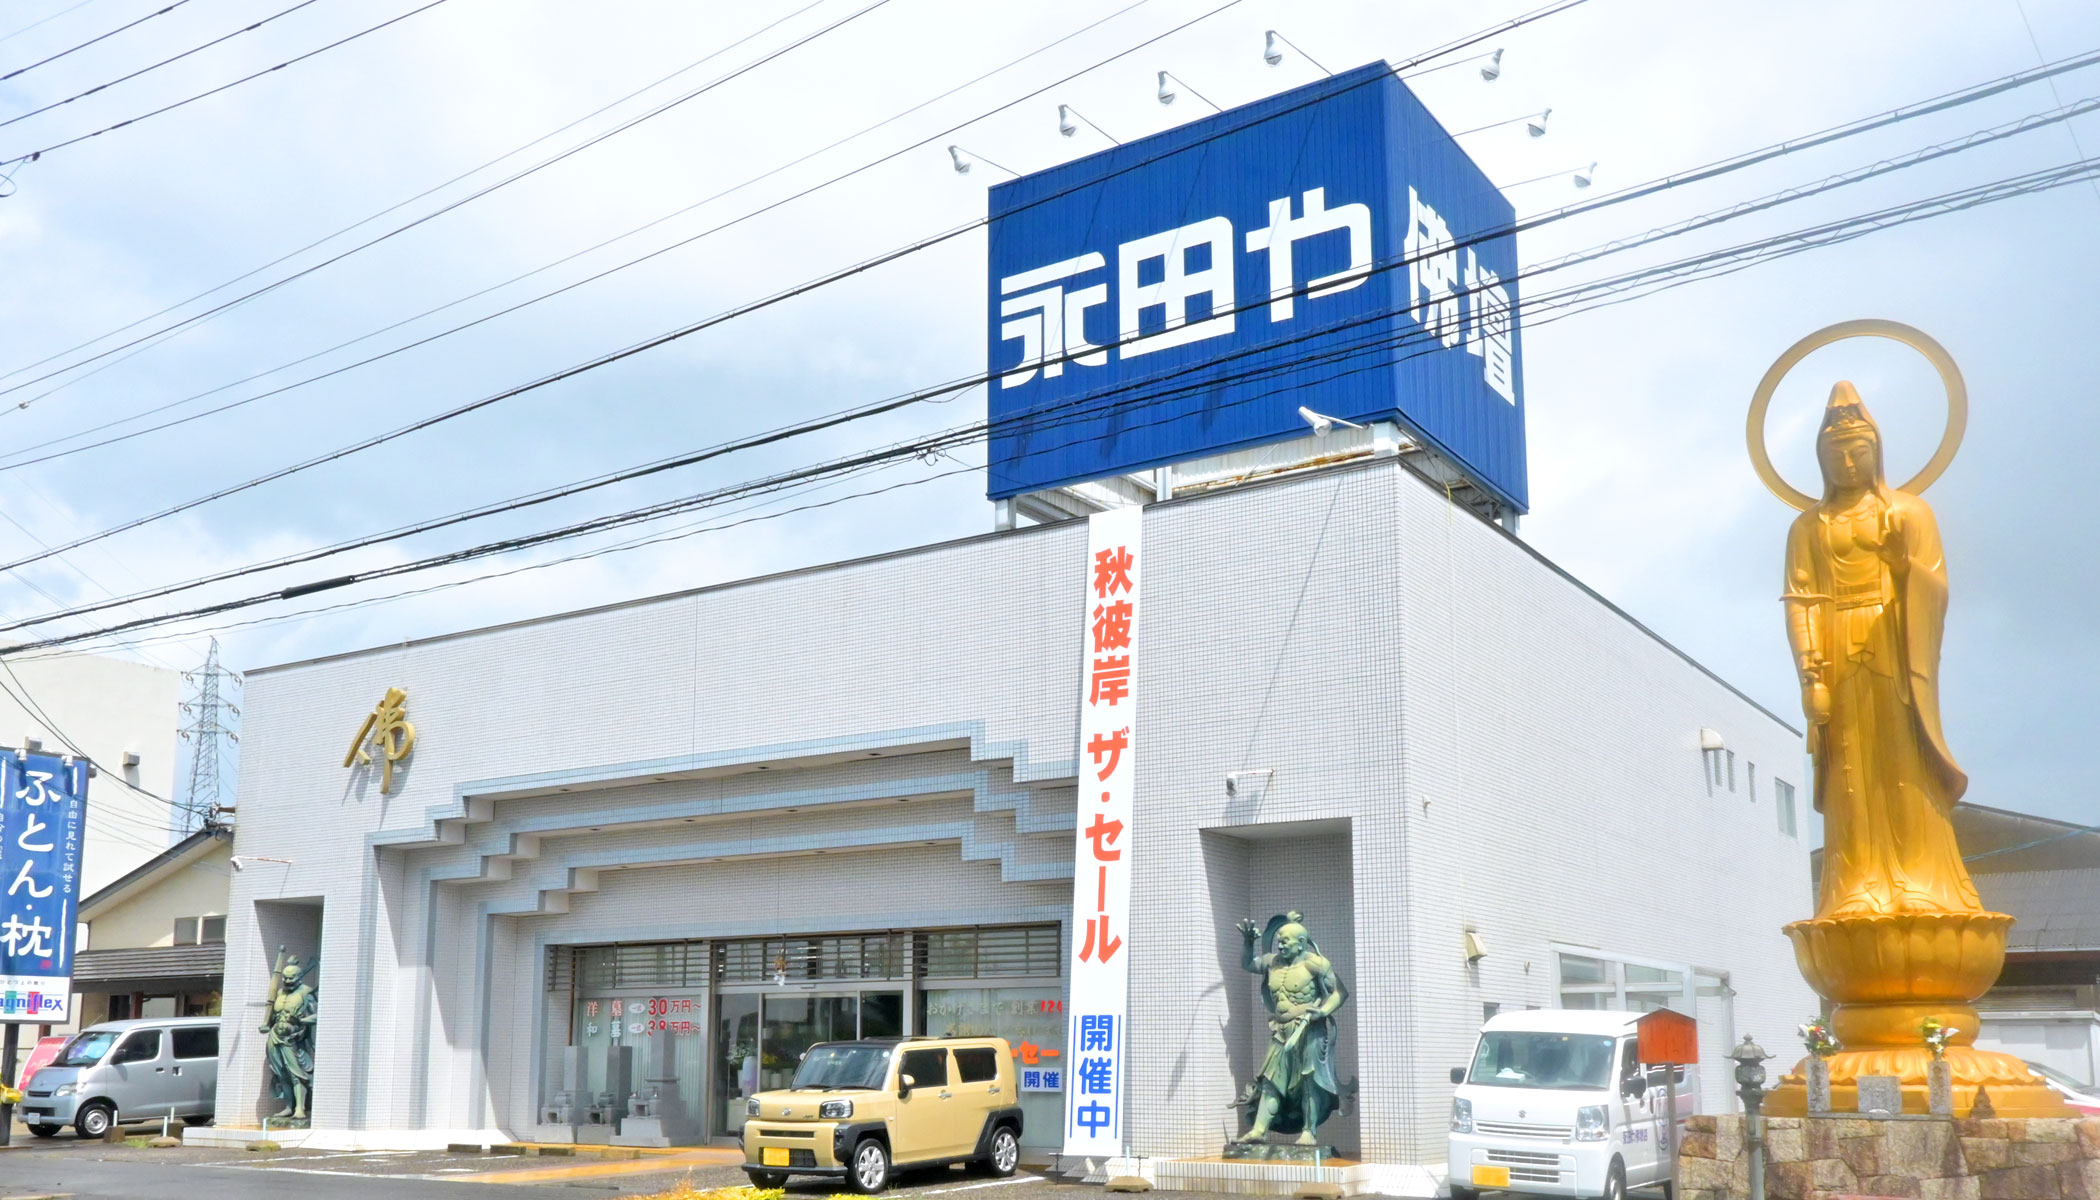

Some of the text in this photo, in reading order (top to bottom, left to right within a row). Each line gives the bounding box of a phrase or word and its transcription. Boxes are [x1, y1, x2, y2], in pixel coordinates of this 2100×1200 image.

[1001, 187, 1373, 389] 永田や
[1078, 546, 1134, 964] 秋彼岸 ザ・セール
[62, 799, 78, 894] 自由に見れて試せる
[1077, 1014, 1113, 1139] 開催中
